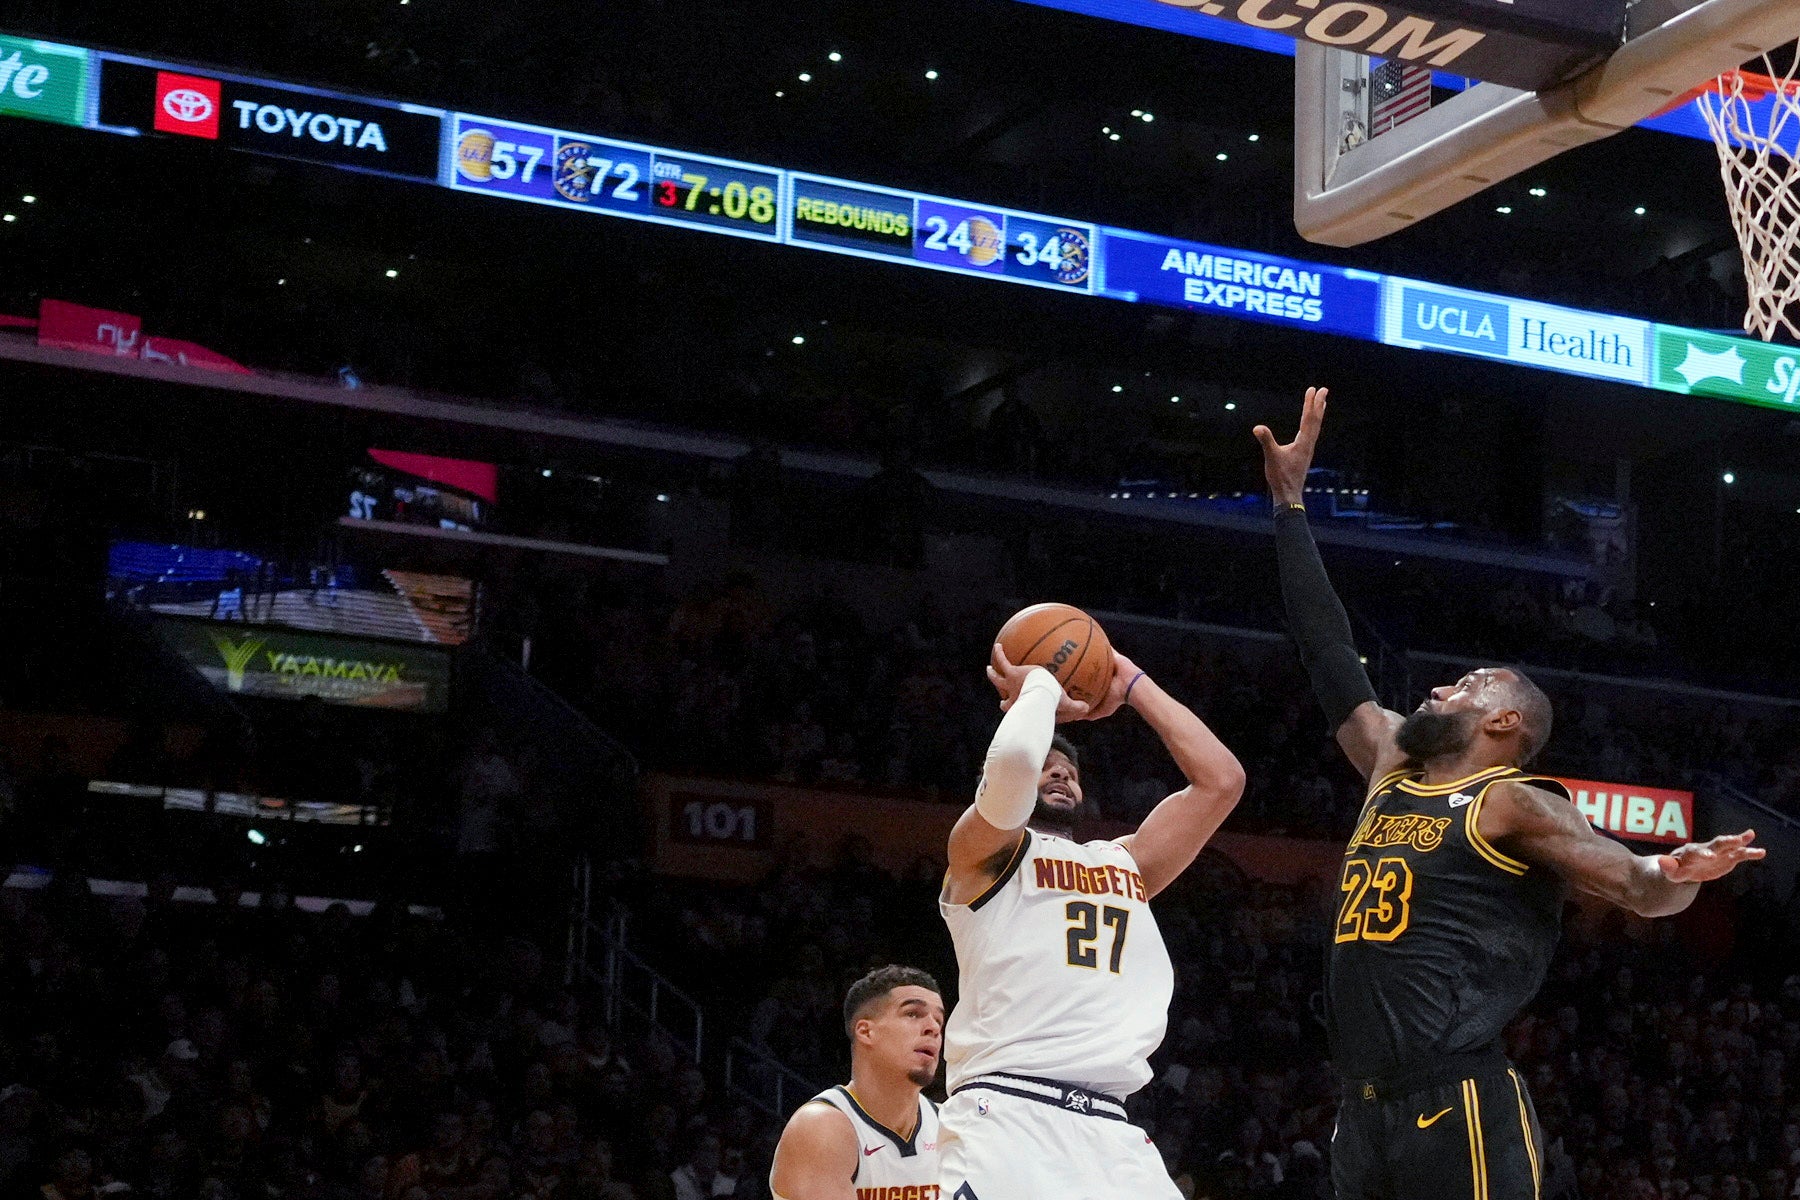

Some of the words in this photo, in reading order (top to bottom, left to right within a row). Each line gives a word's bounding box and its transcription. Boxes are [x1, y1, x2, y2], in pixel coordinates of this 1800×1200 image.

[232, 99, 388, 152] TOYOTA
[490, 141, 544, 183] 57
[585, 156, 640, 201] 72
[653, 161, 682, 181] QTR
[659, 180, 678, 207] 3
[681, 173, 775, 223] 7:08
[796, 197, 910, 238] REBOUNDS
[923, 215, 971, 254] 24
[1016, 231, 1062, 271] 34
[1161, 248, 1321, 297] AMERICAN
[1183, 277, 1323, 322] EXPRESS
[1416, 302, 1496, 341] UCLA
[1520, 317, 1632, 367] Health
[684, 800, 757, 840] 101
[1344, 804, 1452, 853] LAKERS
[1033, 857, 1148, 904] NUGGETS
[1334, 856, 1413, 944] 23
[1065, 900, 1131, 976] 27
